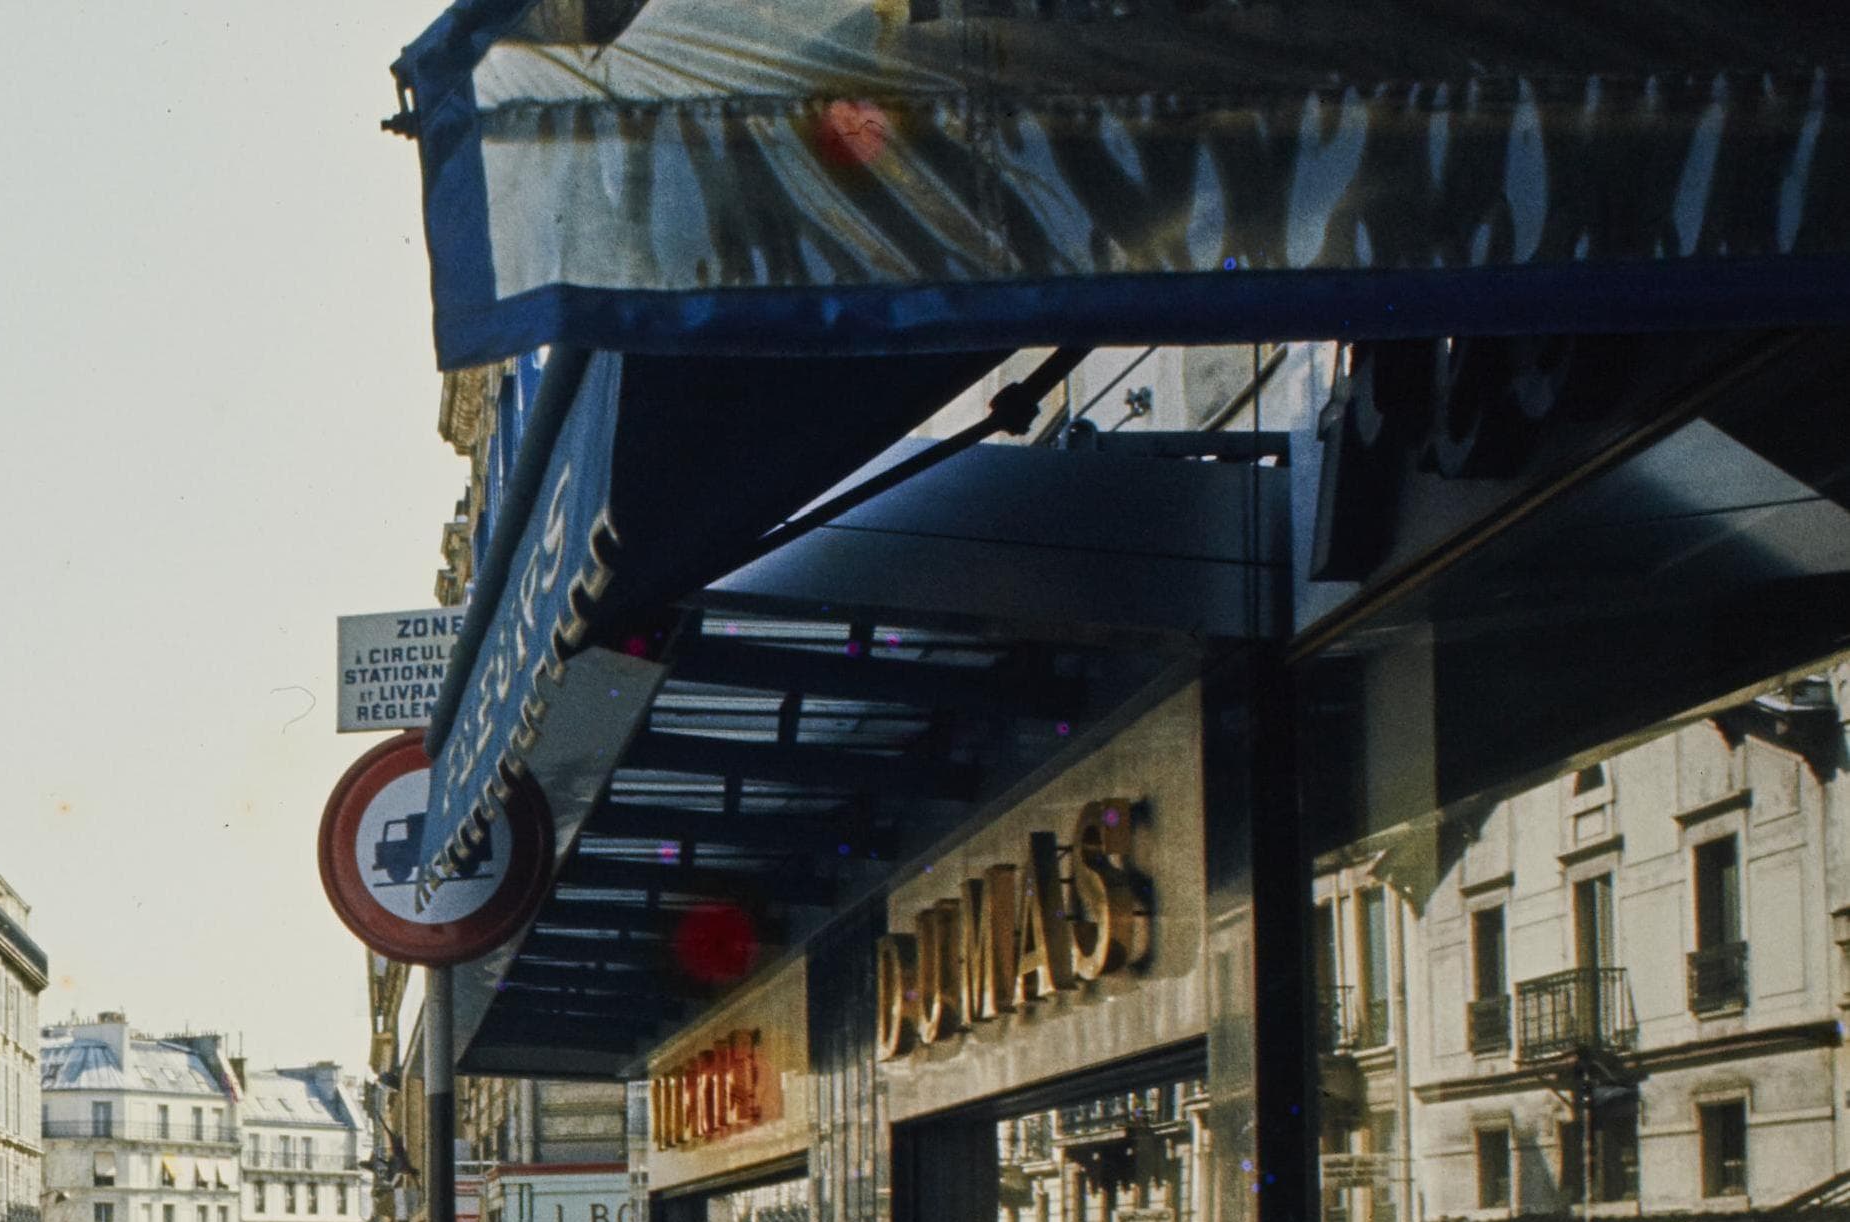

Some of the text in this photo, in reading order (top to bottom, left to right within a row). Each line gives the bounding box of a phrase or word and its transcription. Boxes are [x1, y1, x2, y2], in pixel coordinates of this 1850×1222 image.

[396, 615, 465, 640] ZONE
[369, 645, 453, 664] CIRCUL
[344, 664, 444, 685] STATIONN
[379, 683, 438, 701] LIVRA
[877, 798, 1153, 1062] DUMAS
